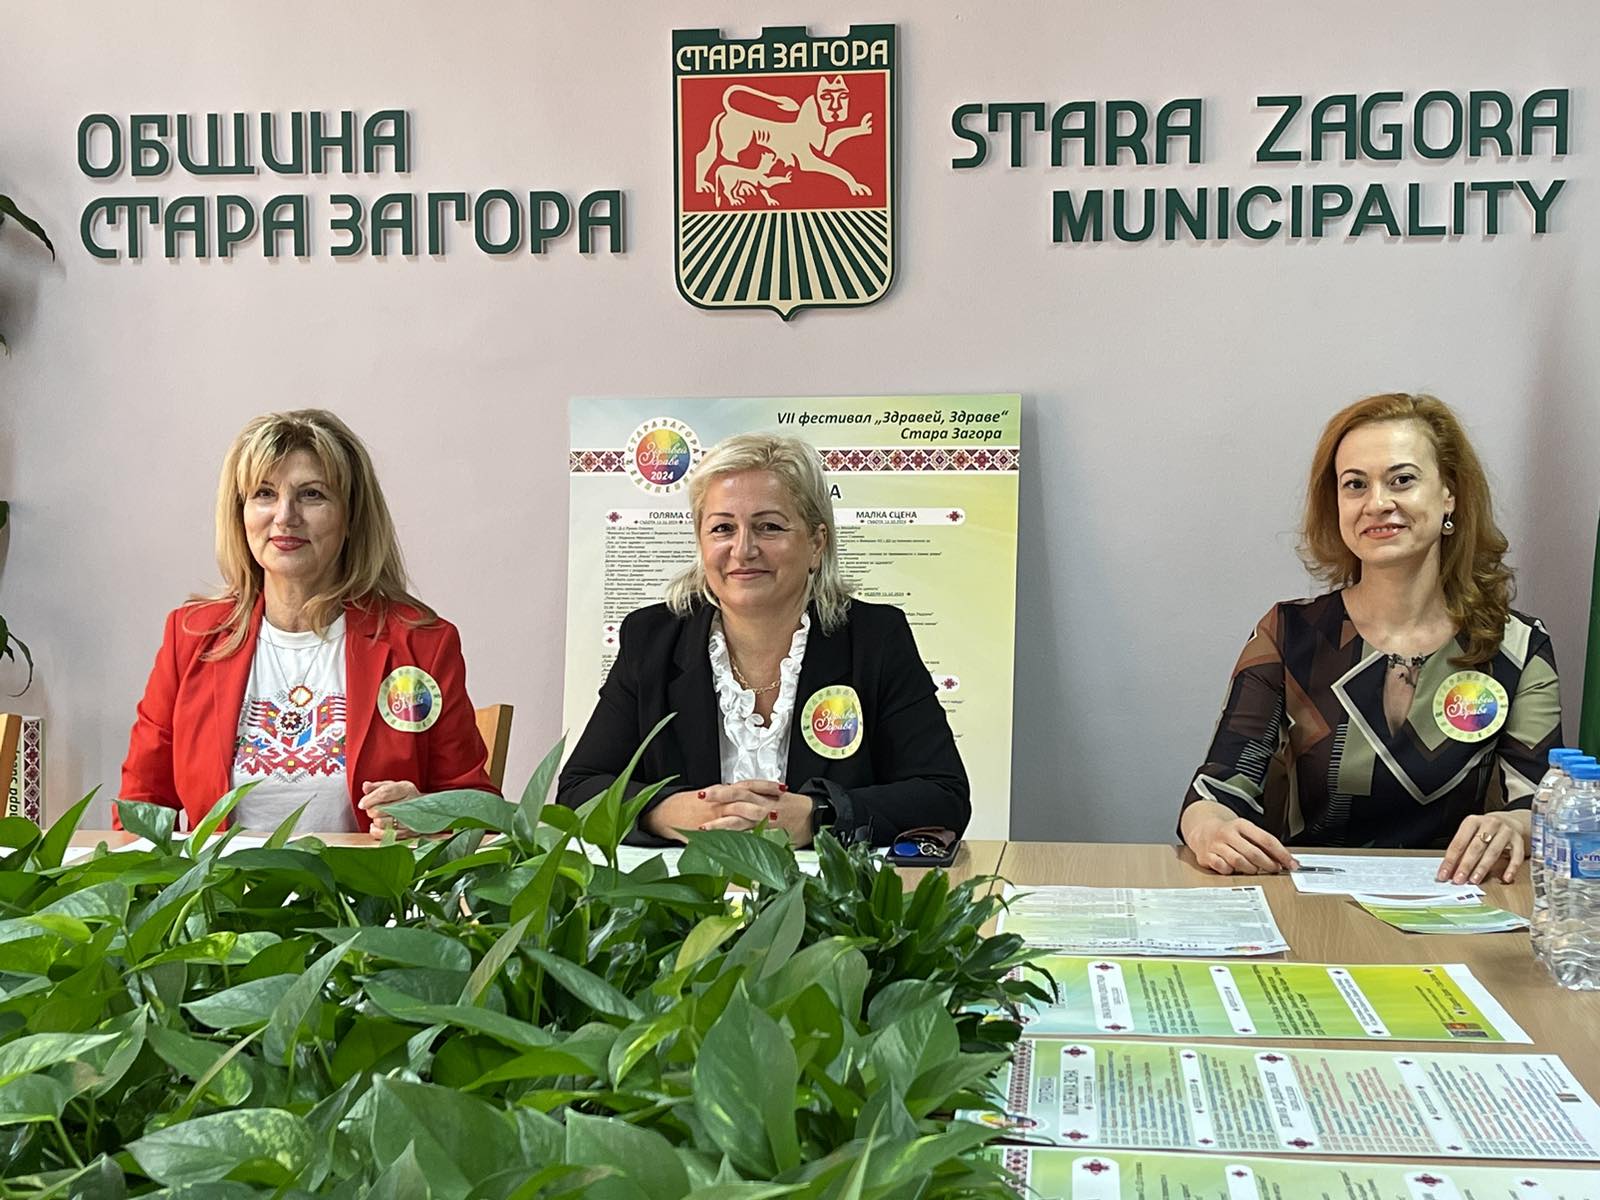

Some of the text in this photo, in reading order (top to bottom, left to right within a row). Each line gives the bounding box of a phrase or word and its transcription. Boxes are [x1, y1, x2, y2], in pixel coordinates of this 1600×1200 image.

[676, 39, 889, 71] СТАРА ЗАГОРА
[952, 88, 1569, 169] STARA ZAGORA
[78, 110, 409, 177] ОБЩИНА
[1052, 179, 1567, 243] MUNICIPALITY
[80, 188, 624, 259] СТАРА ЗАГОРА
[776, 411, 796, 424] VII
[798, 411, 872, 428] фестивал
[900, 426, 1003, 442] Стара Загора
[650, 470, 675, 481] 2024
[648, 511, 685, 520] ГОЛЯМА
[855, 510, 918, 520] МАЛКА СЦЕНА
